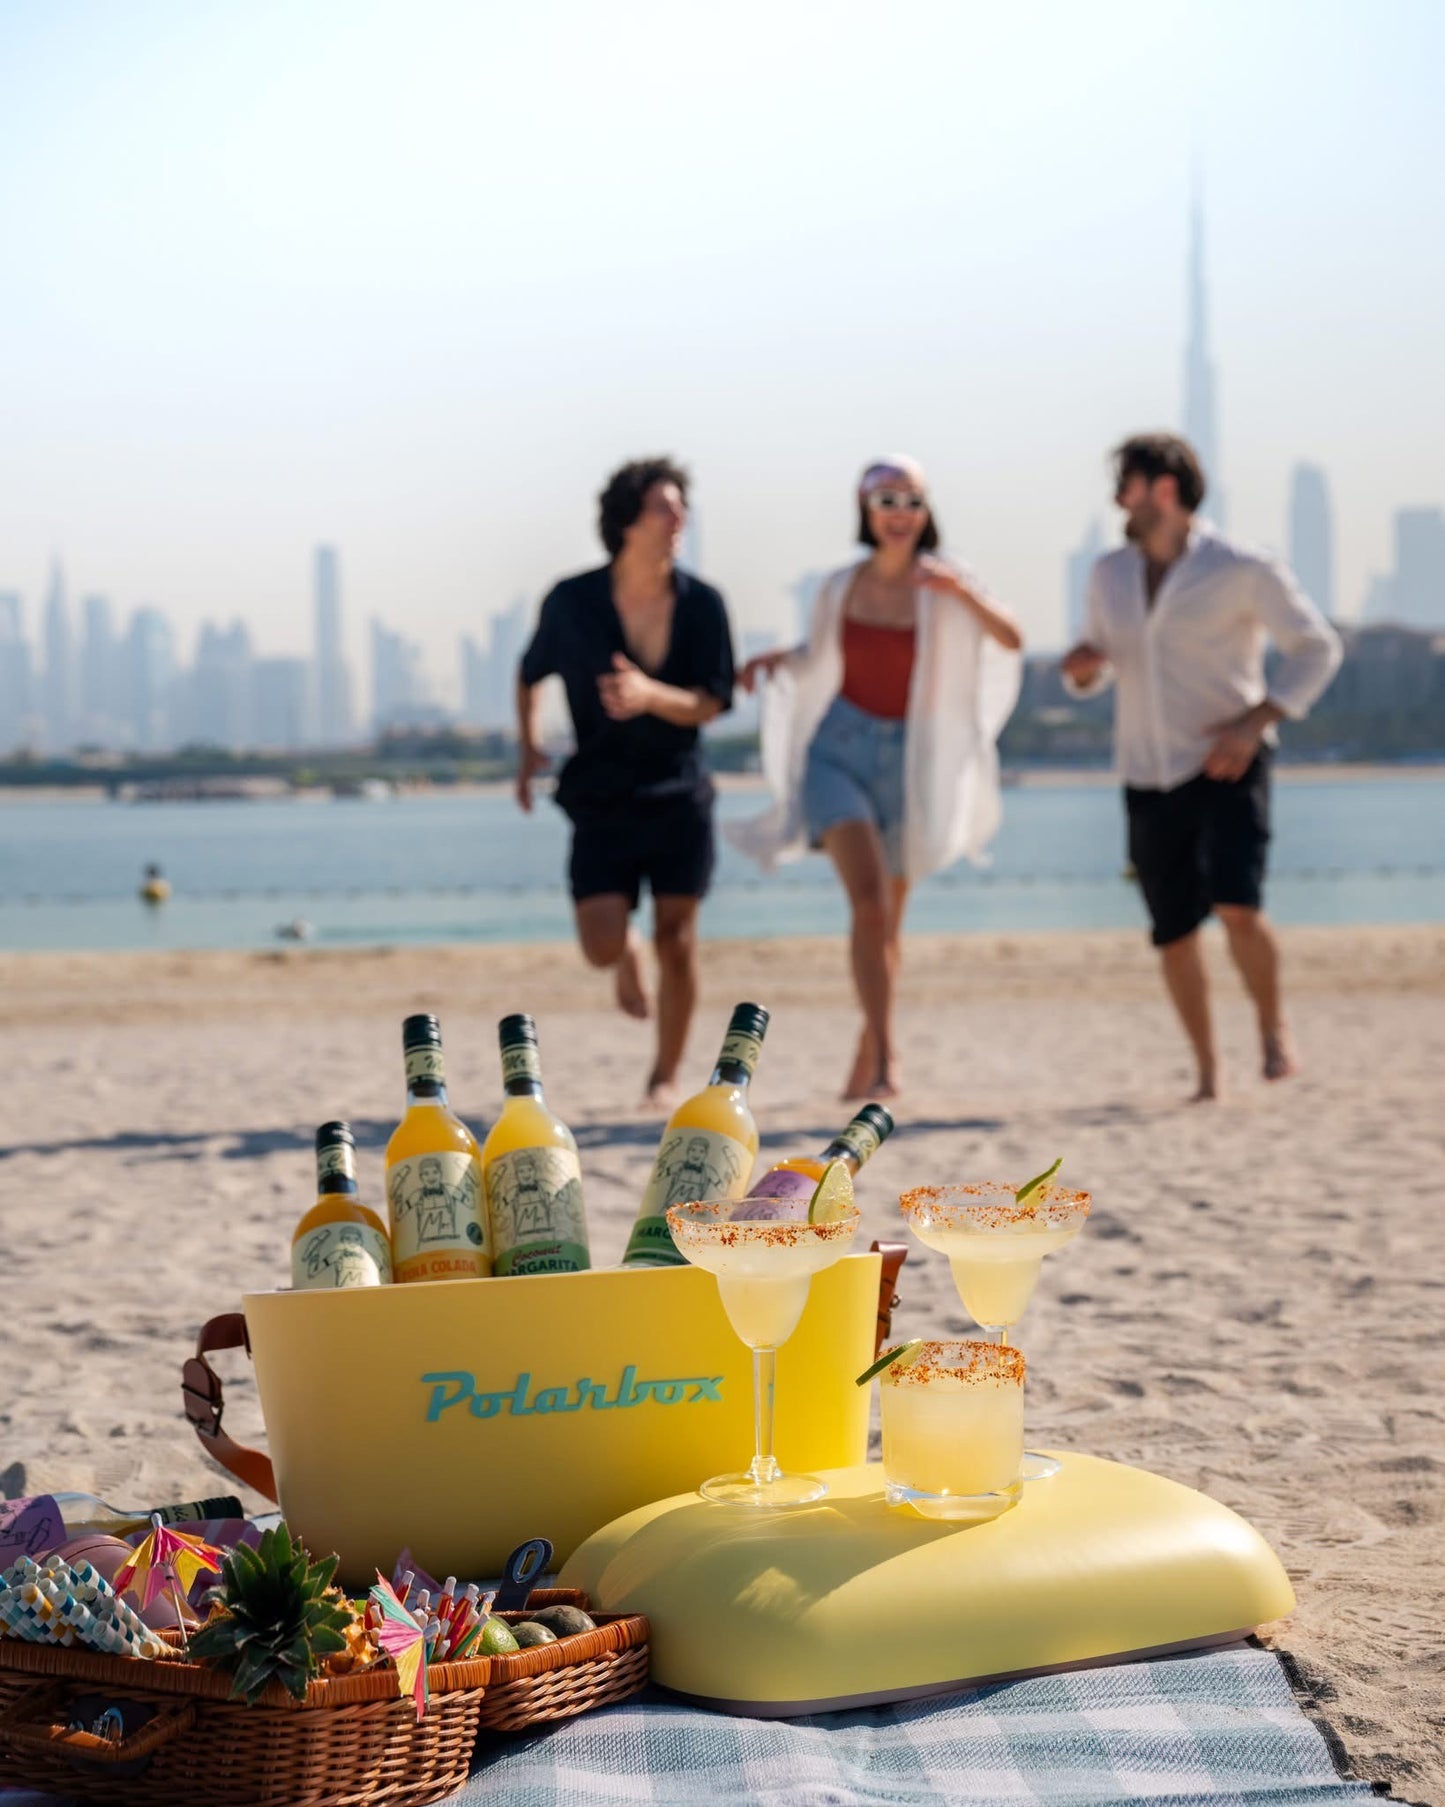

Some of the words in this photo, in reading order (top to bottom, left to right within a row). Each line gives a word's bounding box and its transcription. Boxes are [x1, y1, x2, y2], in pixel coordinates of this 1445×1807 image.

[637, 1226, 671, 1240] MARG
[431, 1258, 477, 1273] COLADA
[512, 1244, 562, 1268] Coconut
[505, 1258, 578, 1277] ARGARITA
[420, 1365, 724, 1423] Polarbox
